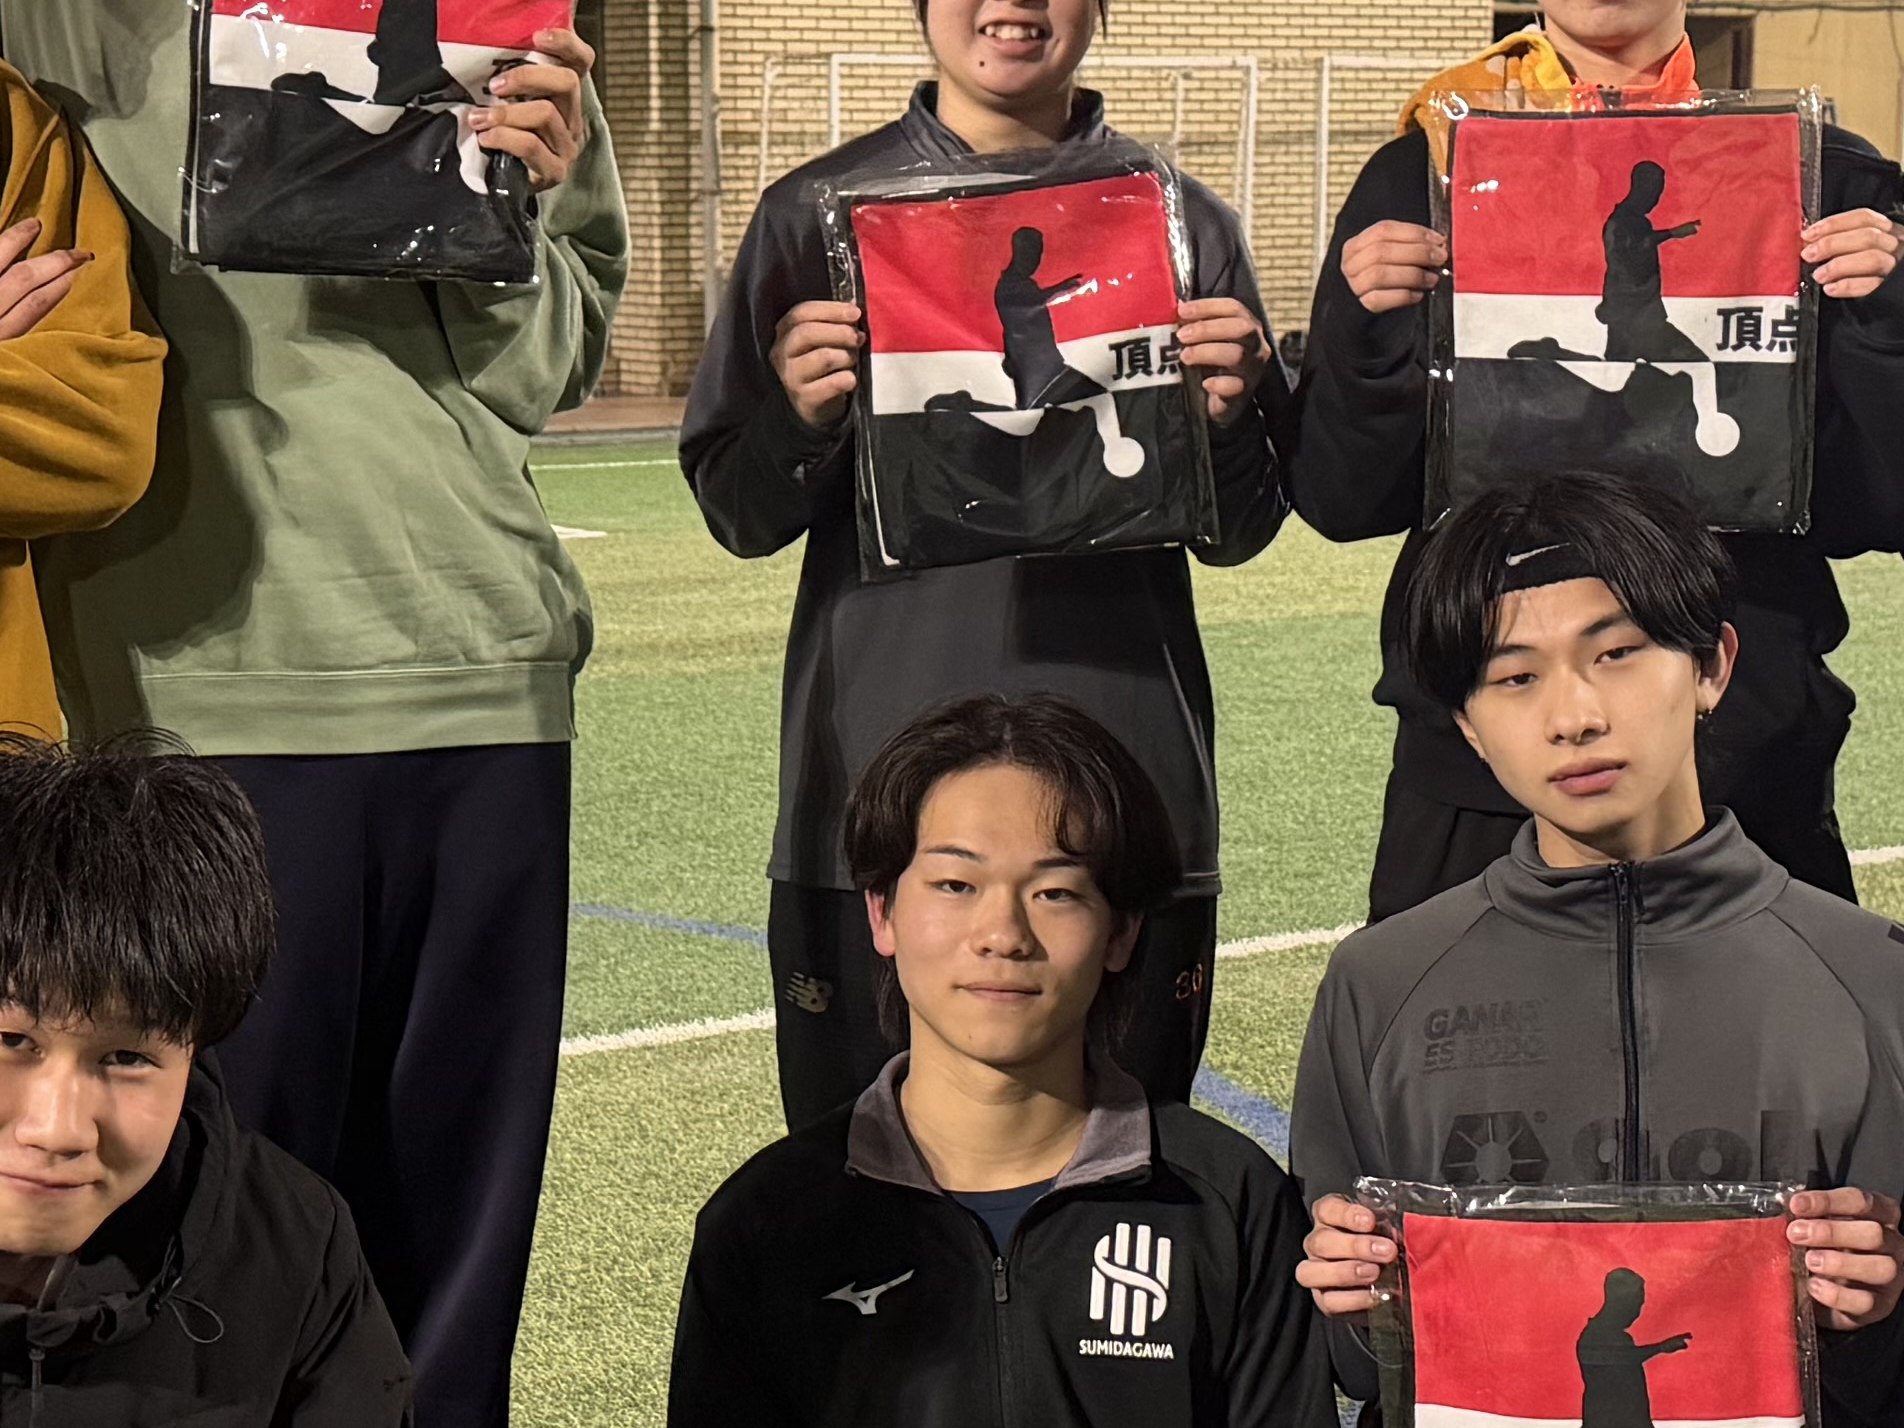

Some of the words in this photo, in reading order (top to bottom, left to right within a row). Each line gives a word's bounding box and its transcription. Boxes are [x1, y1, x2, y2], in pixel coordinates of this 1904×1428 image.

[1716, 304, 1799, 353] 頂点
[1108, 332, 1182, 381] 頂点
[1078, 1339, 1175, 1360] SUMIDAGAWA
